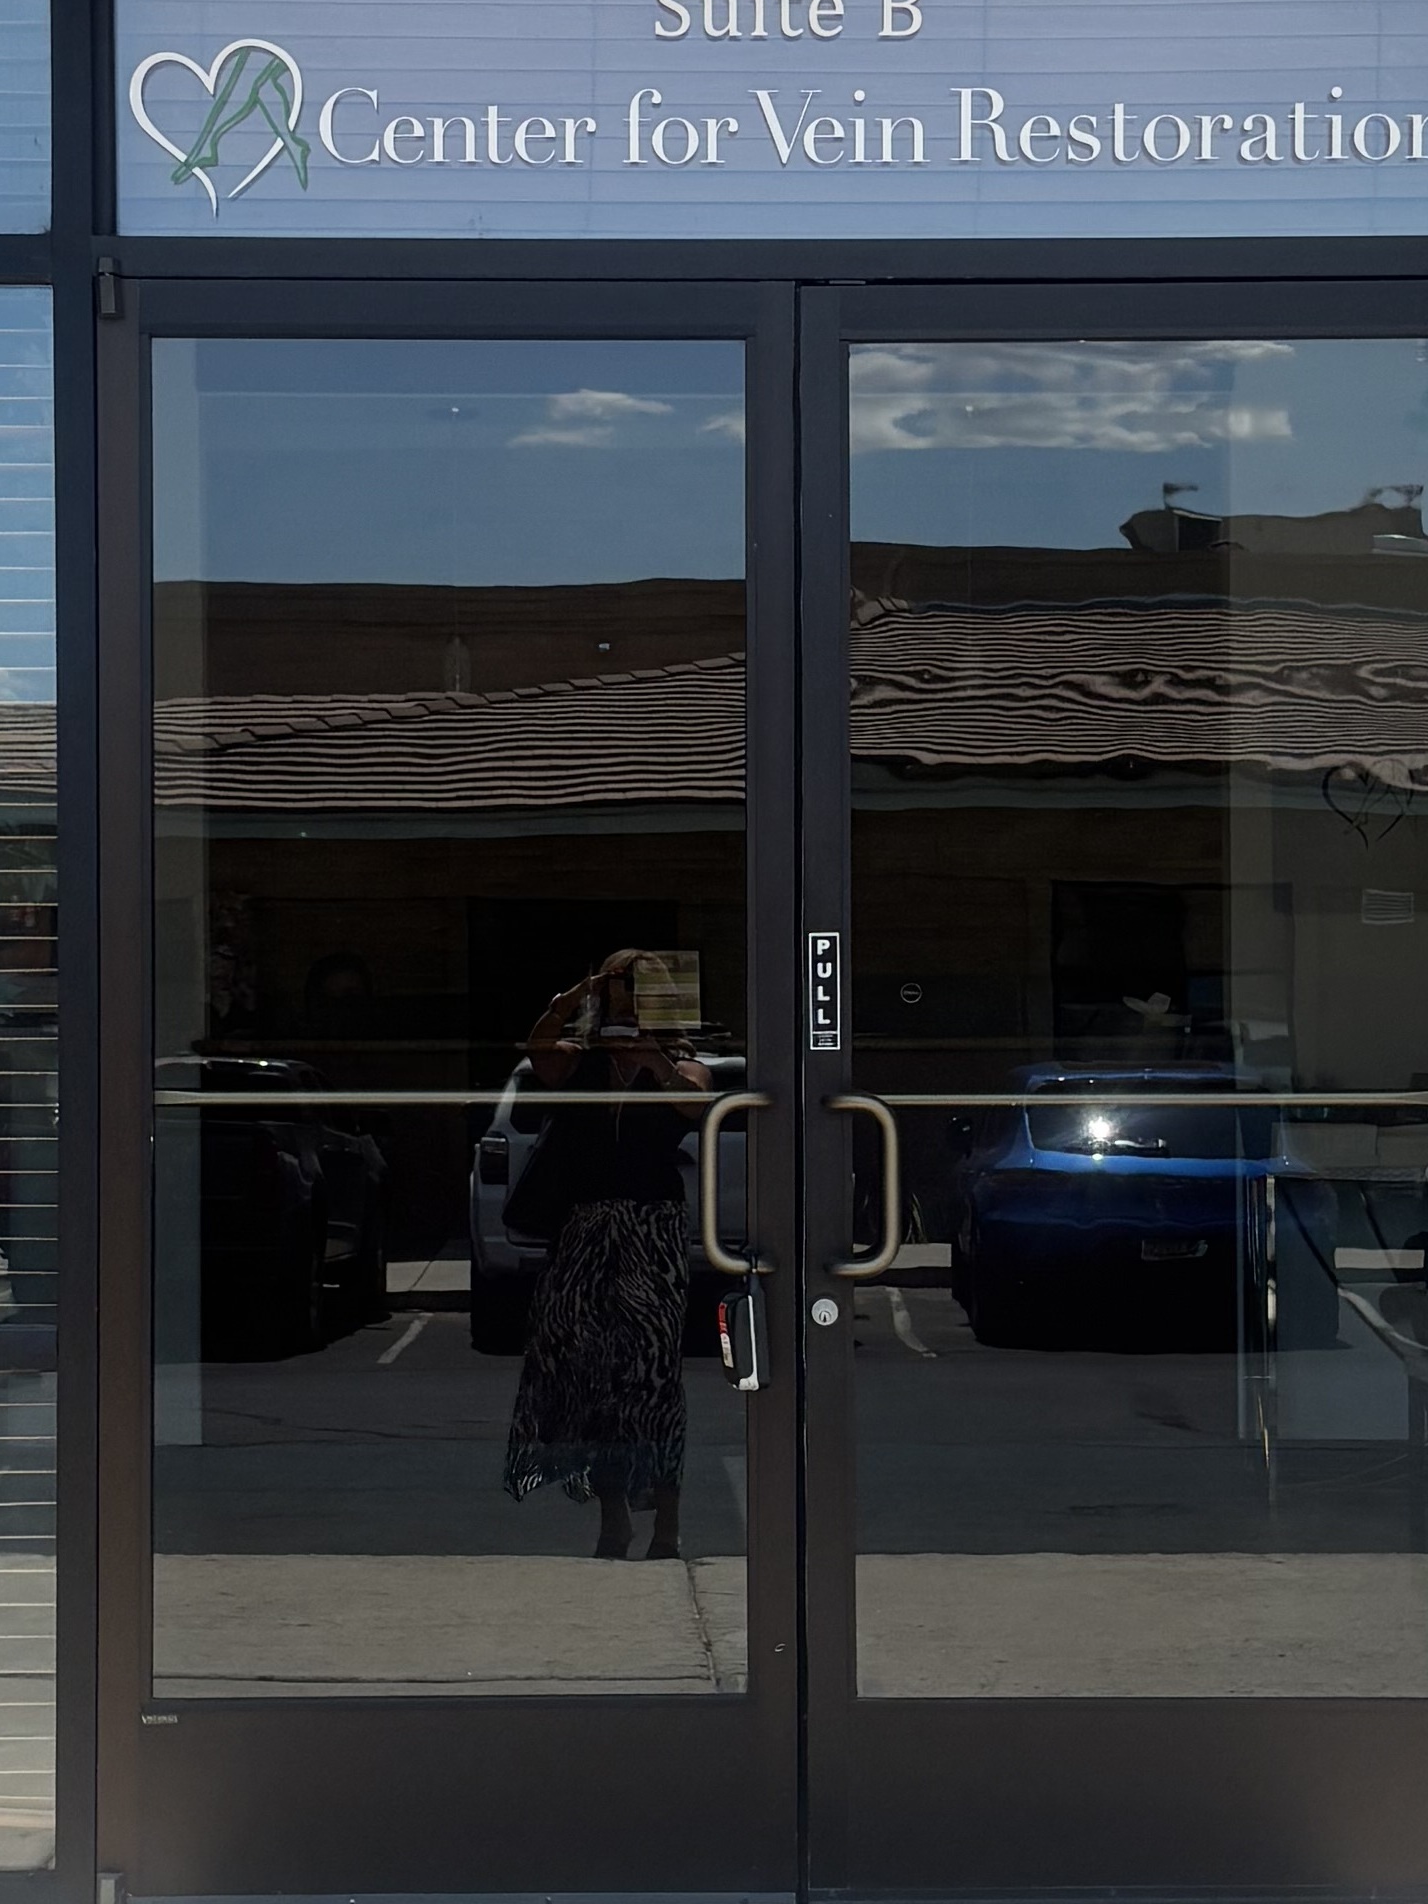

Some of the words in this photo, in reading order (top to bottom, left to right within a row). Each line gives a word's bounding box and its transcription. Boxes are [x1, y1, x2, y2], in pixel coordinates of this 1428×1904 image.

[318, 87, 597, 167] Center
[622, 88, 739, 165] for
[748, 89, 928, 167] Vein
[816, 939, 832, 1024] PULL
